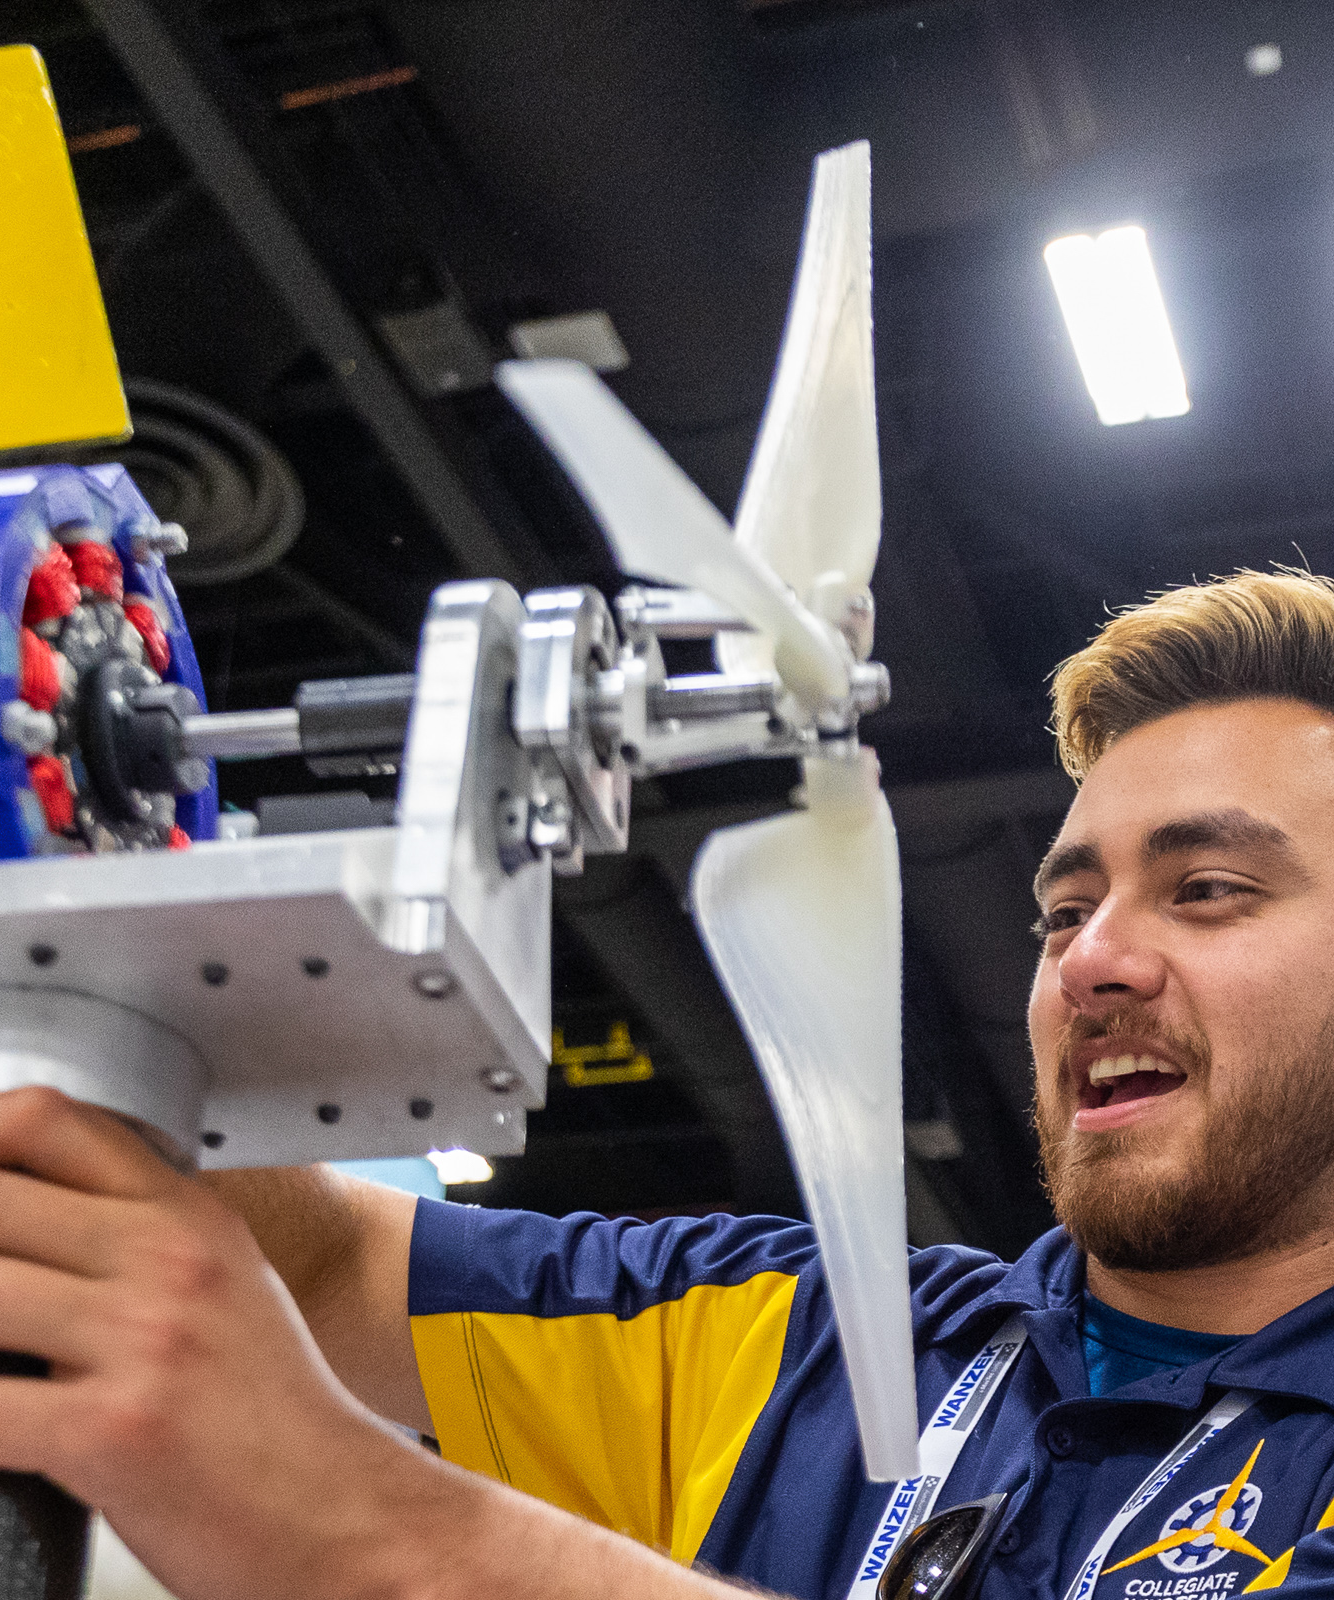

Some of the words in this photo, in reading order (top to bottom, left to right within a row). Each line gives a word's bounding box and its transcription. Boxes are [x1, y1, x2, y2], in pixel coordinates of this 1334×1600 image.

[932, 1342, 1004, 1429] WANZEK
[860, 1474, 924, 1582] WANZEK
[1125, 1571, 1239, 1597] COLLEGIATE
